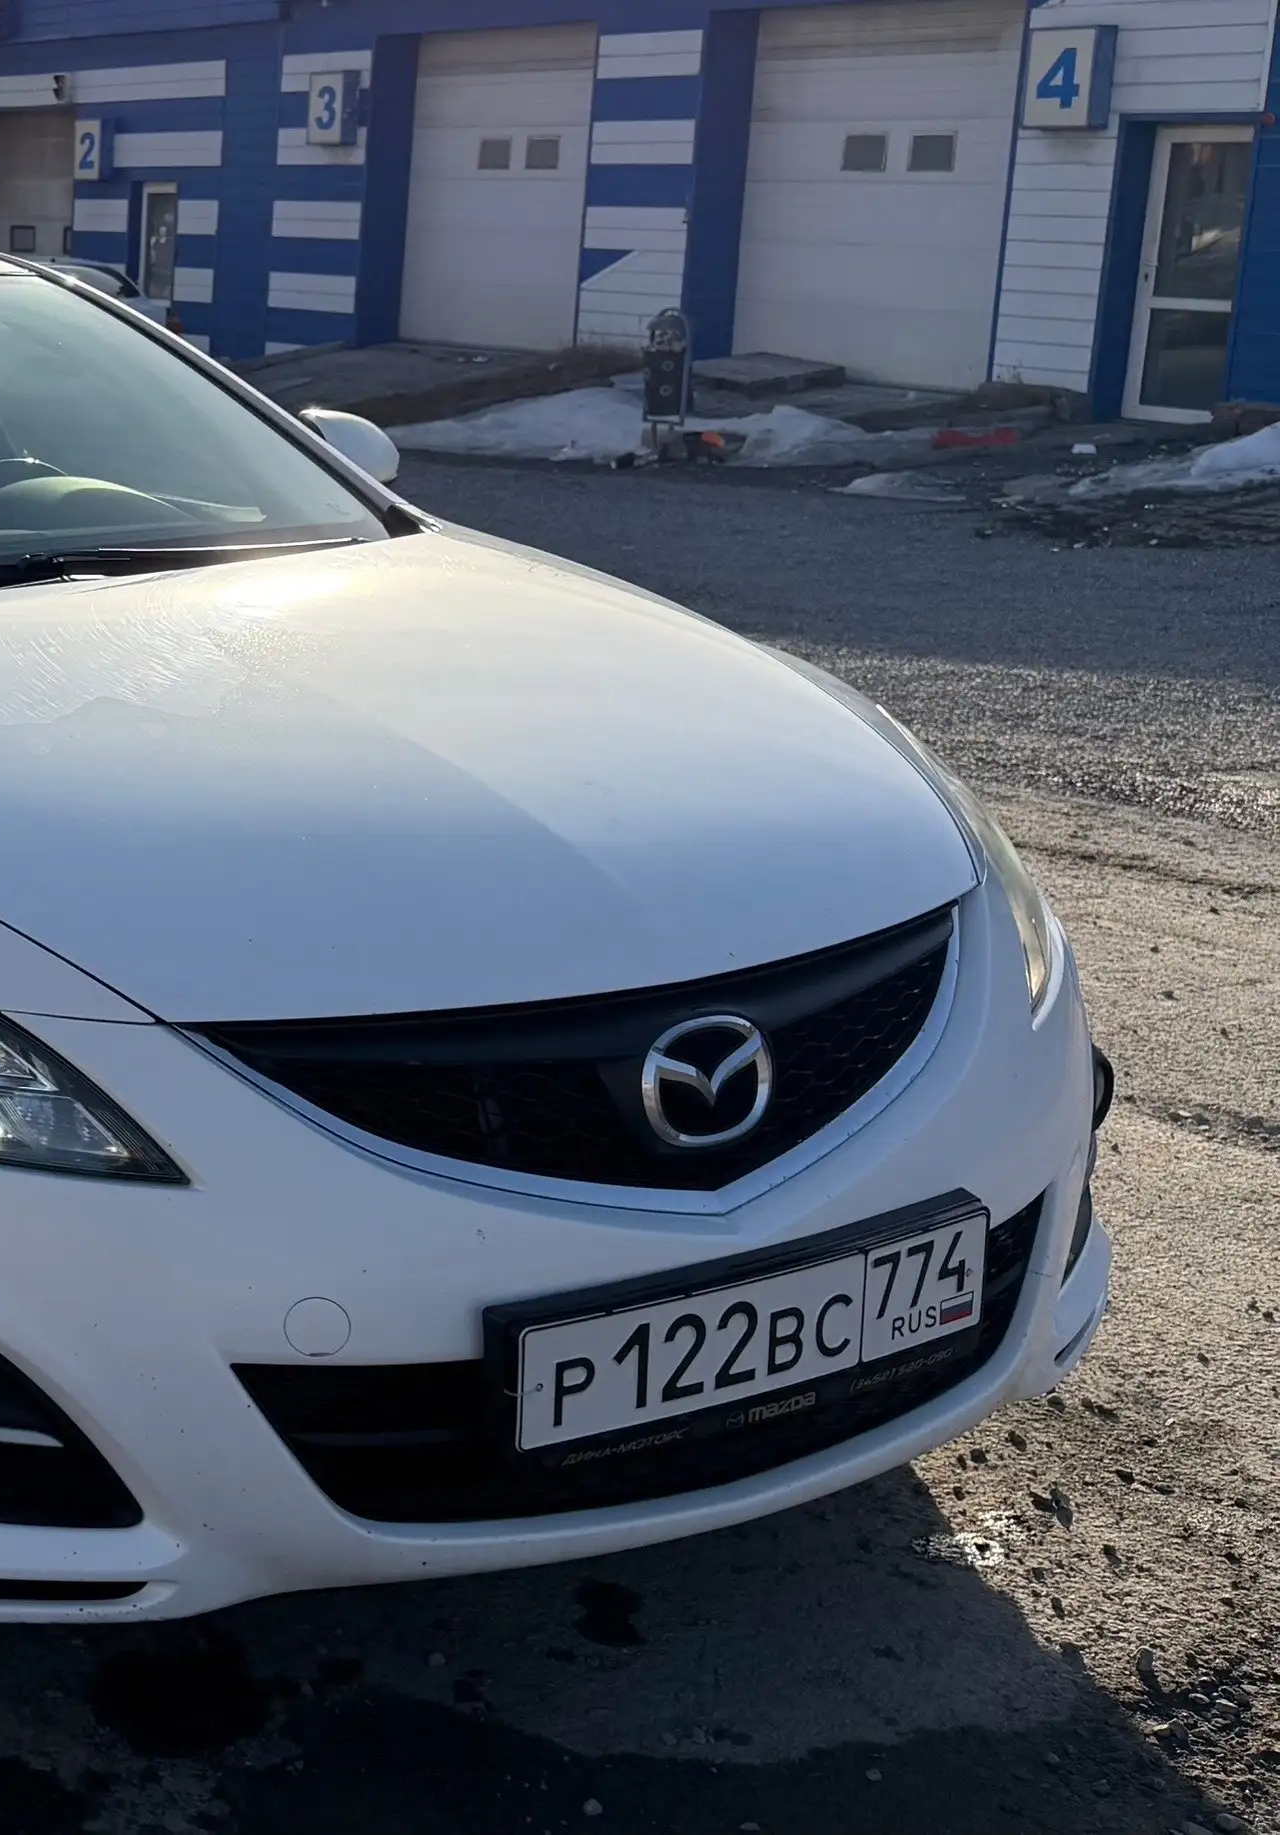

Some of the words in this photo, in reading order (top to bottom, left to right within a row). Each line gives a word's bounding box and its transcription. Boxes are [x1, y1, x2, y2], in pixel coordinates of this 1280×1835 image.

[1036, 47, 1080, 109] 4
[315, 85, 337, 131] 3
[79, 131, 96, 170] 2
[871, 1230, 966, 1320] 774
[891, 1306, 937, 1340] RUS
